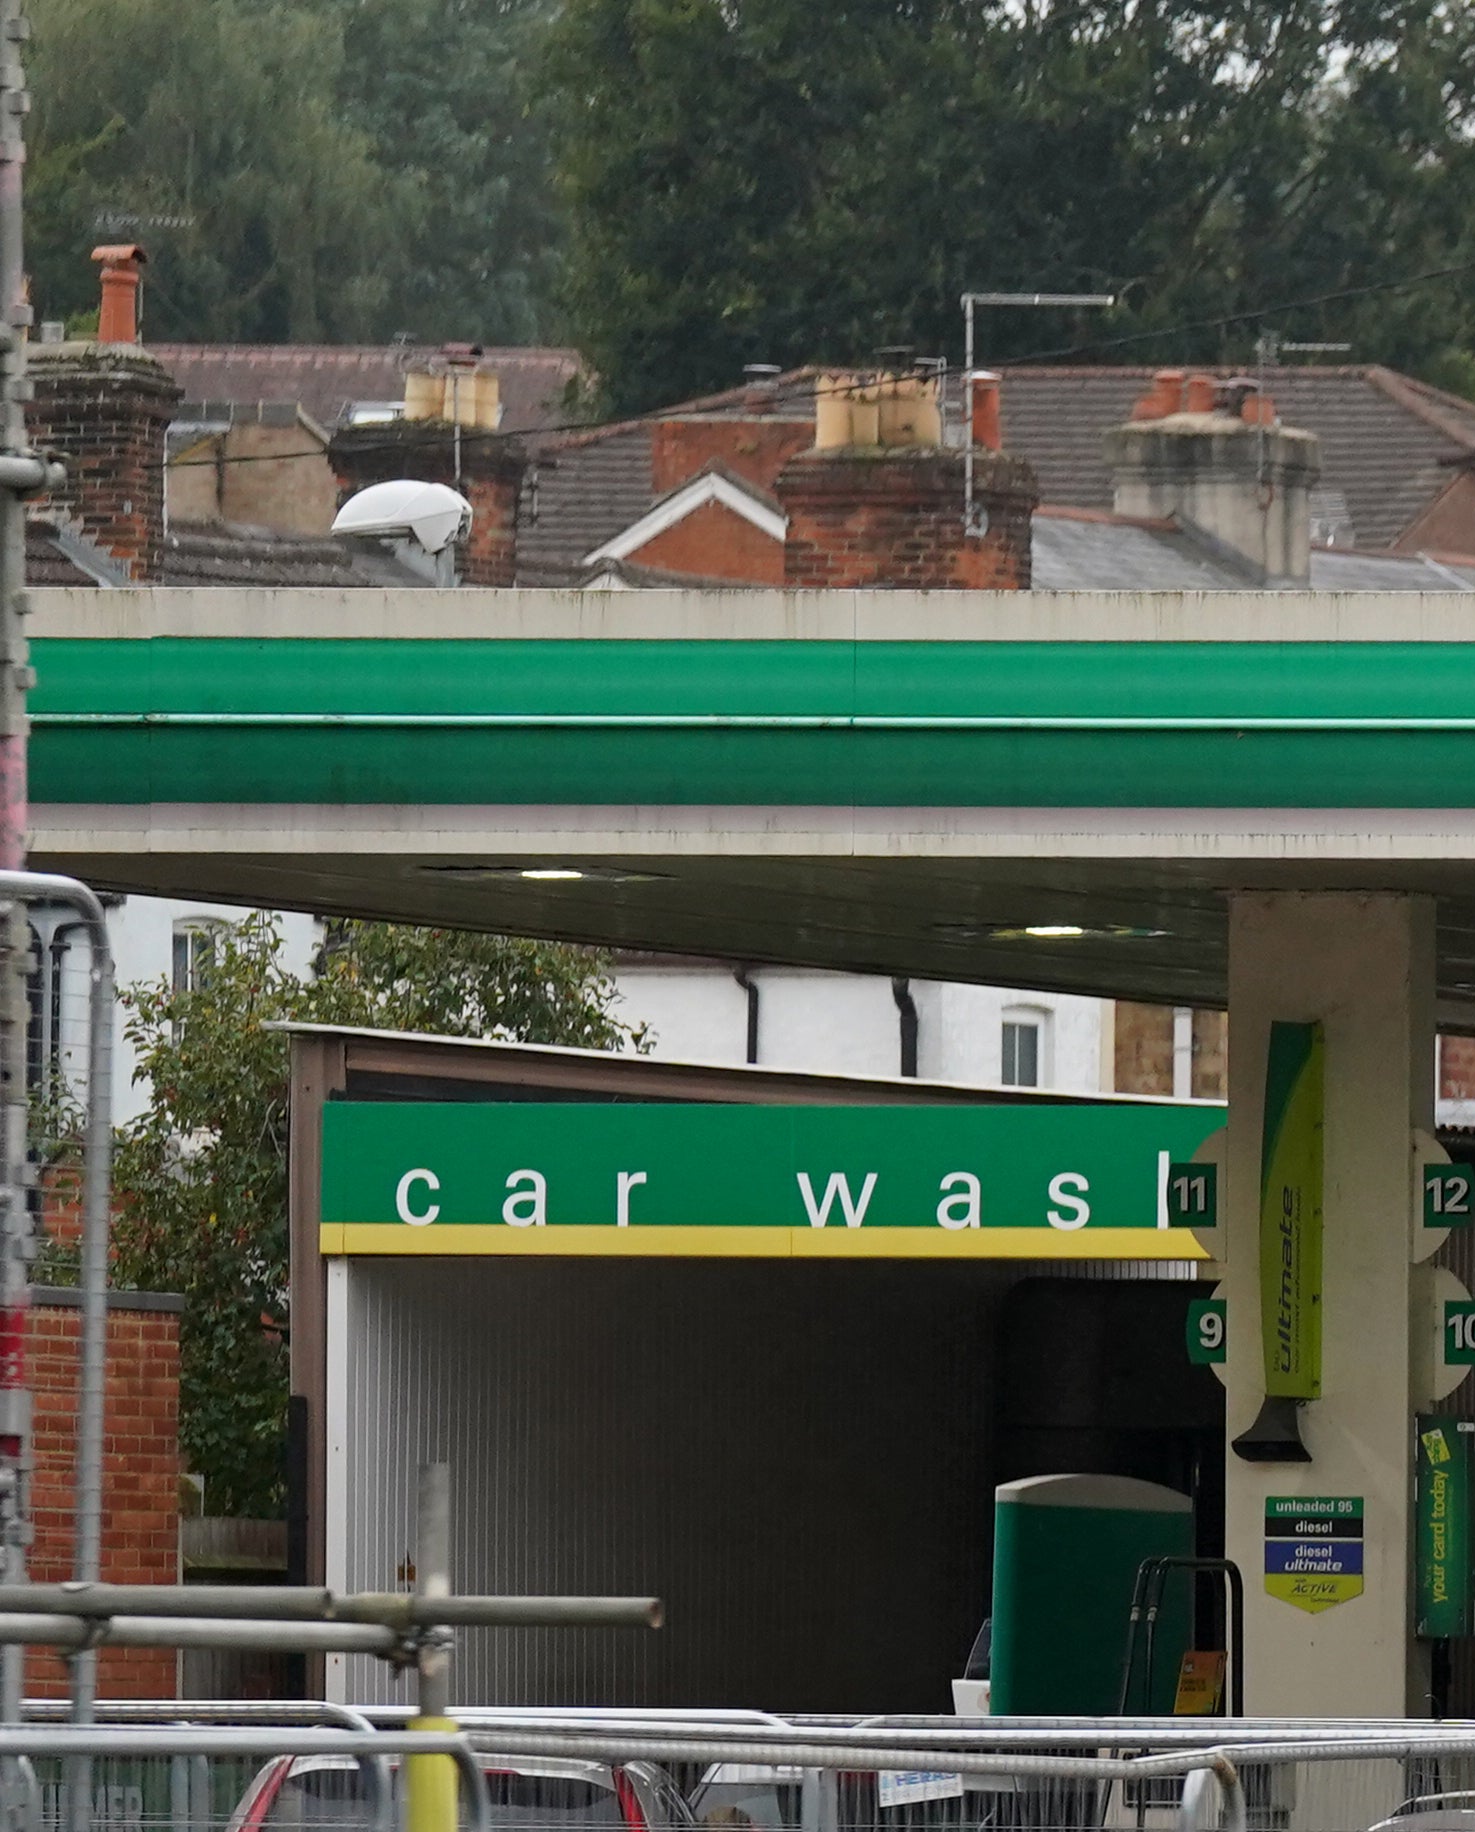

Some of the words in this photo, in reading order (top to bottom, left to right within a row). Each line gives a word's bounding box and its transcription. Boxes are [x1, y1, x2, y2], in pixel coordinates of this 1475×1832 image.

[395, 1168, 648, 1230] car
[1172, 1174, 1209, 1214] 11
[1425, 1176, 1471, 1214] 12
[1277, 1185, 1294, 1374] ultimate
[1199, 1311, 1224, 1352] 9
[1275, 1500, 1335, 1512] unleaded
[1337, 1501, 1353, 1513] 95
[1429, 1469, 1449, 1518] today
[1295, 1520, 1333, 1533] diesel
[1429, 1522, 1446, 1560] card
[1284, 1559, 1343, 1572] ultimate
[1294, 1545, 1333, 1557] diesel
[1432, 1564, 1449, 1604] your
